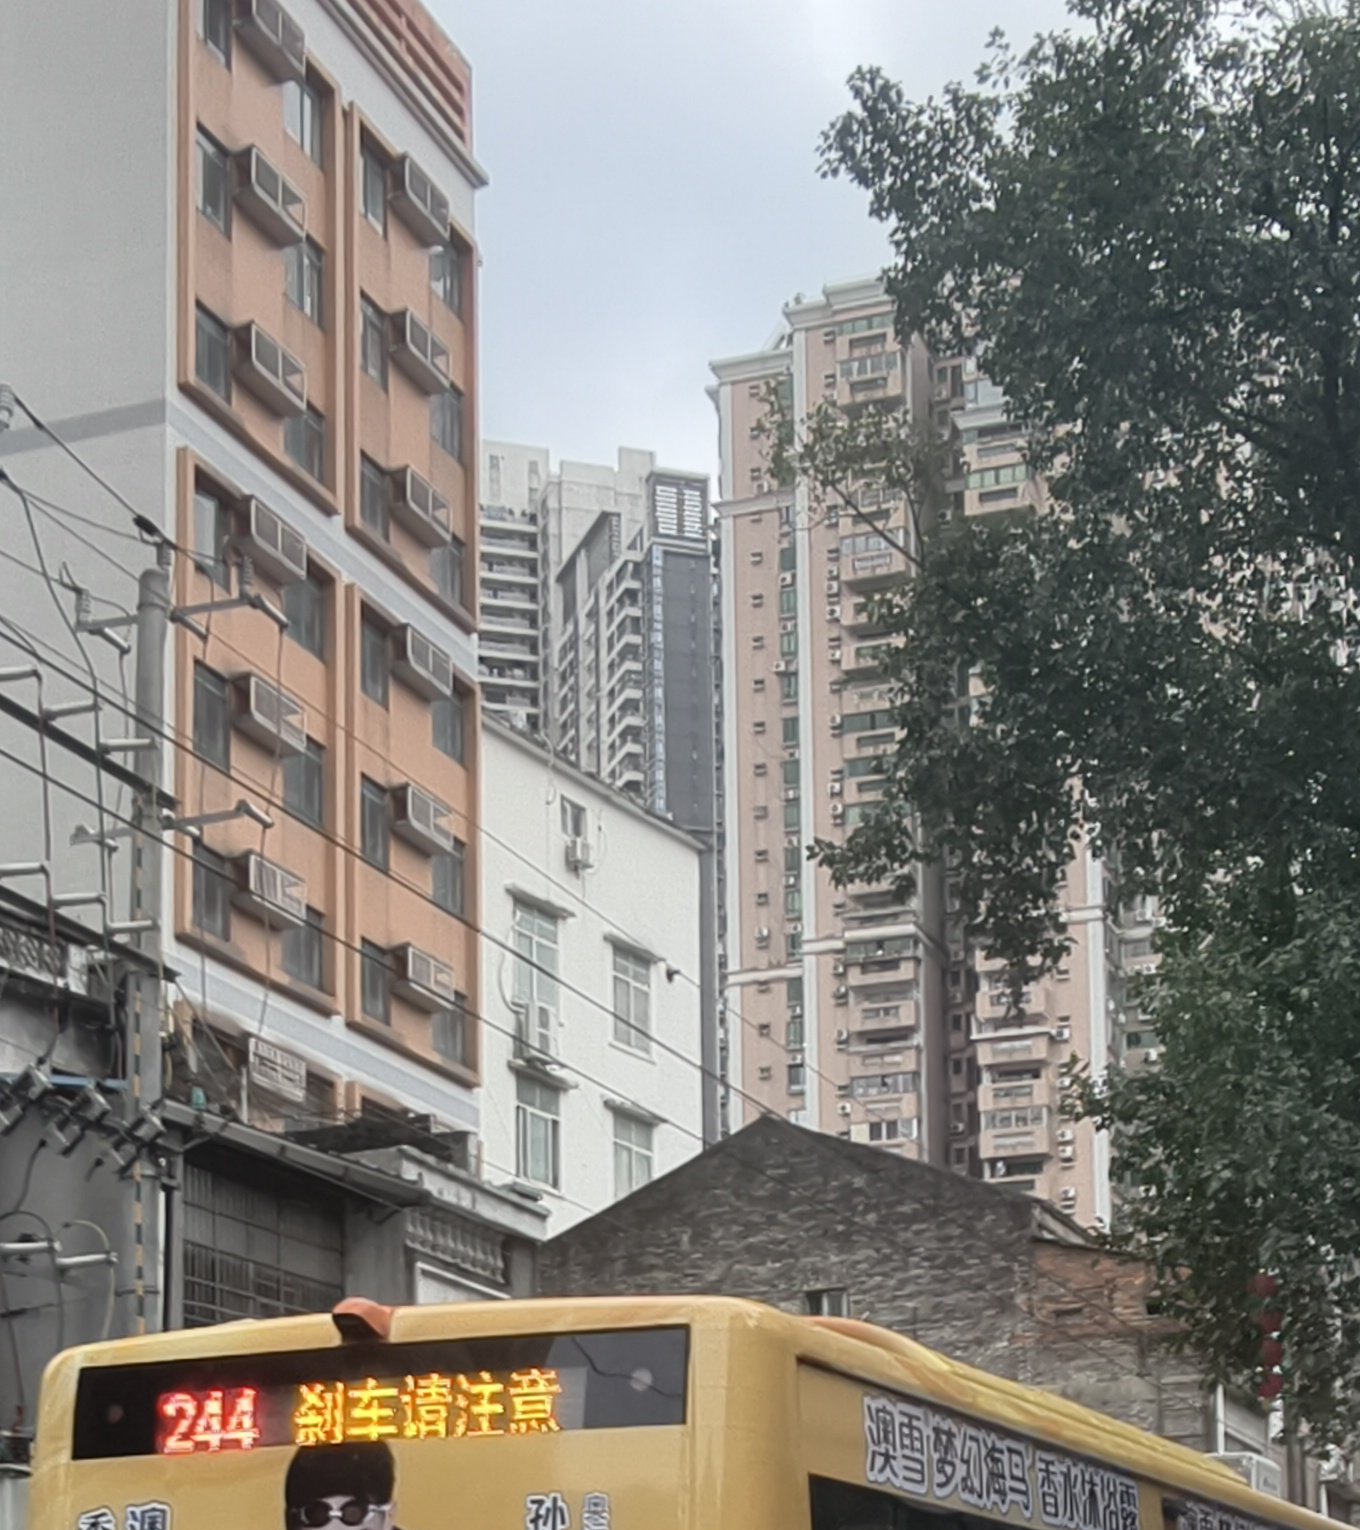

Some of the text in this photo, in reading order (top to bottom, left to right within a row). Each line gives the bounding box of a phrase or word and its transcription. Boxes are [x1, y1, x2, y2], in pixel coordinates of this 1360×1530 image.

[162, 1388, 260, 1453] 244
[293, 1368, 561, 1445] 刹车请注意
[868, 1404, 1029, 1512] 澳雪梦幻海马
